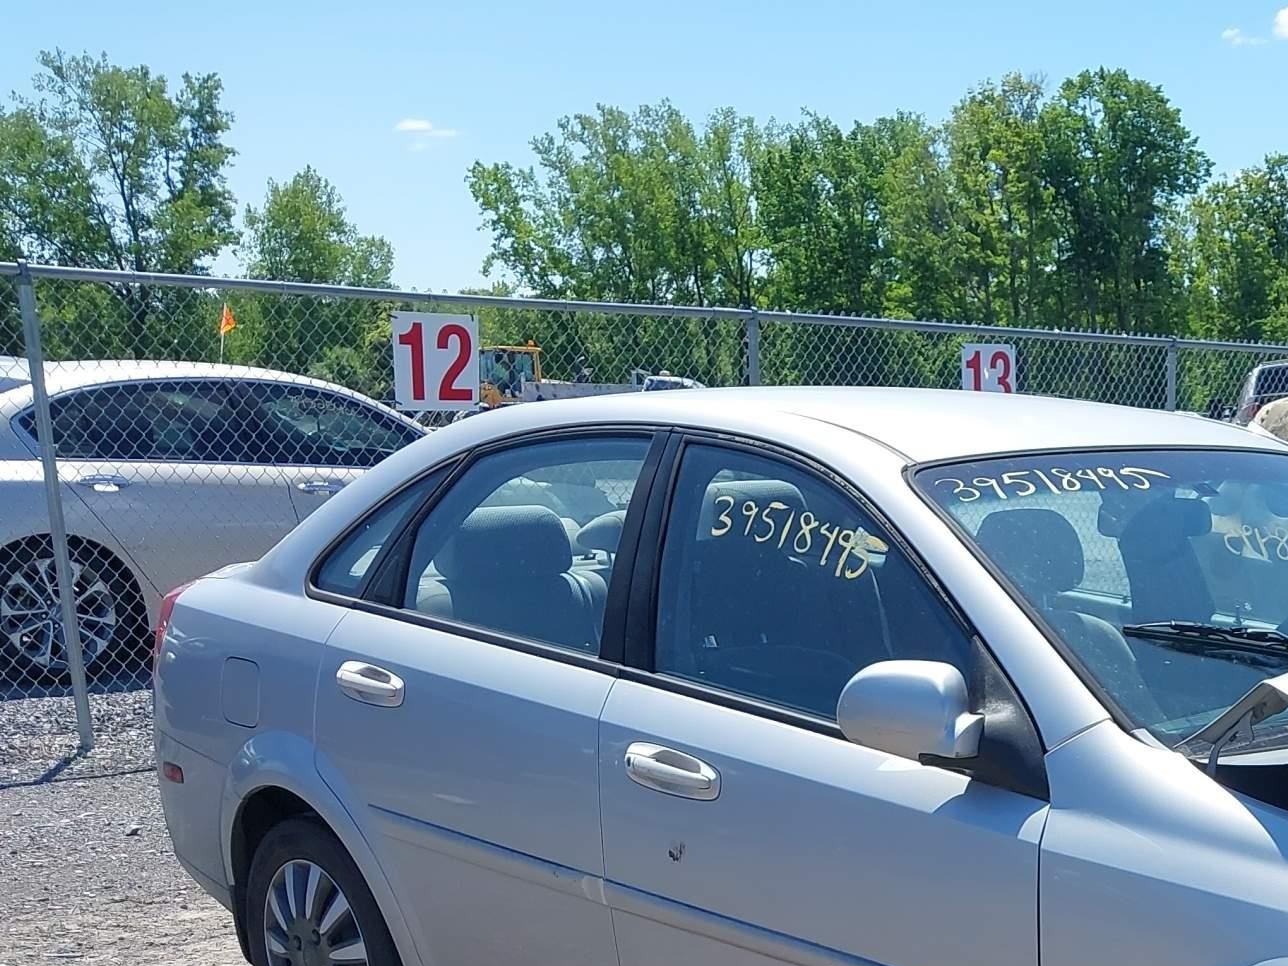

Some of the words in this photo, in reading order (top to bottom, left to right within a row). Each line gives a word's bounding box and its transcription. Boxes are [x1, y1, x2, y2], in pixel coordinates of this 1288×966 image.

[398, 322, 474, 402] 12
[965, 350, 1013, 393] 13
[934, 466, 1171, 502] 39518495
[711, 495, 890, 580] 39518495
